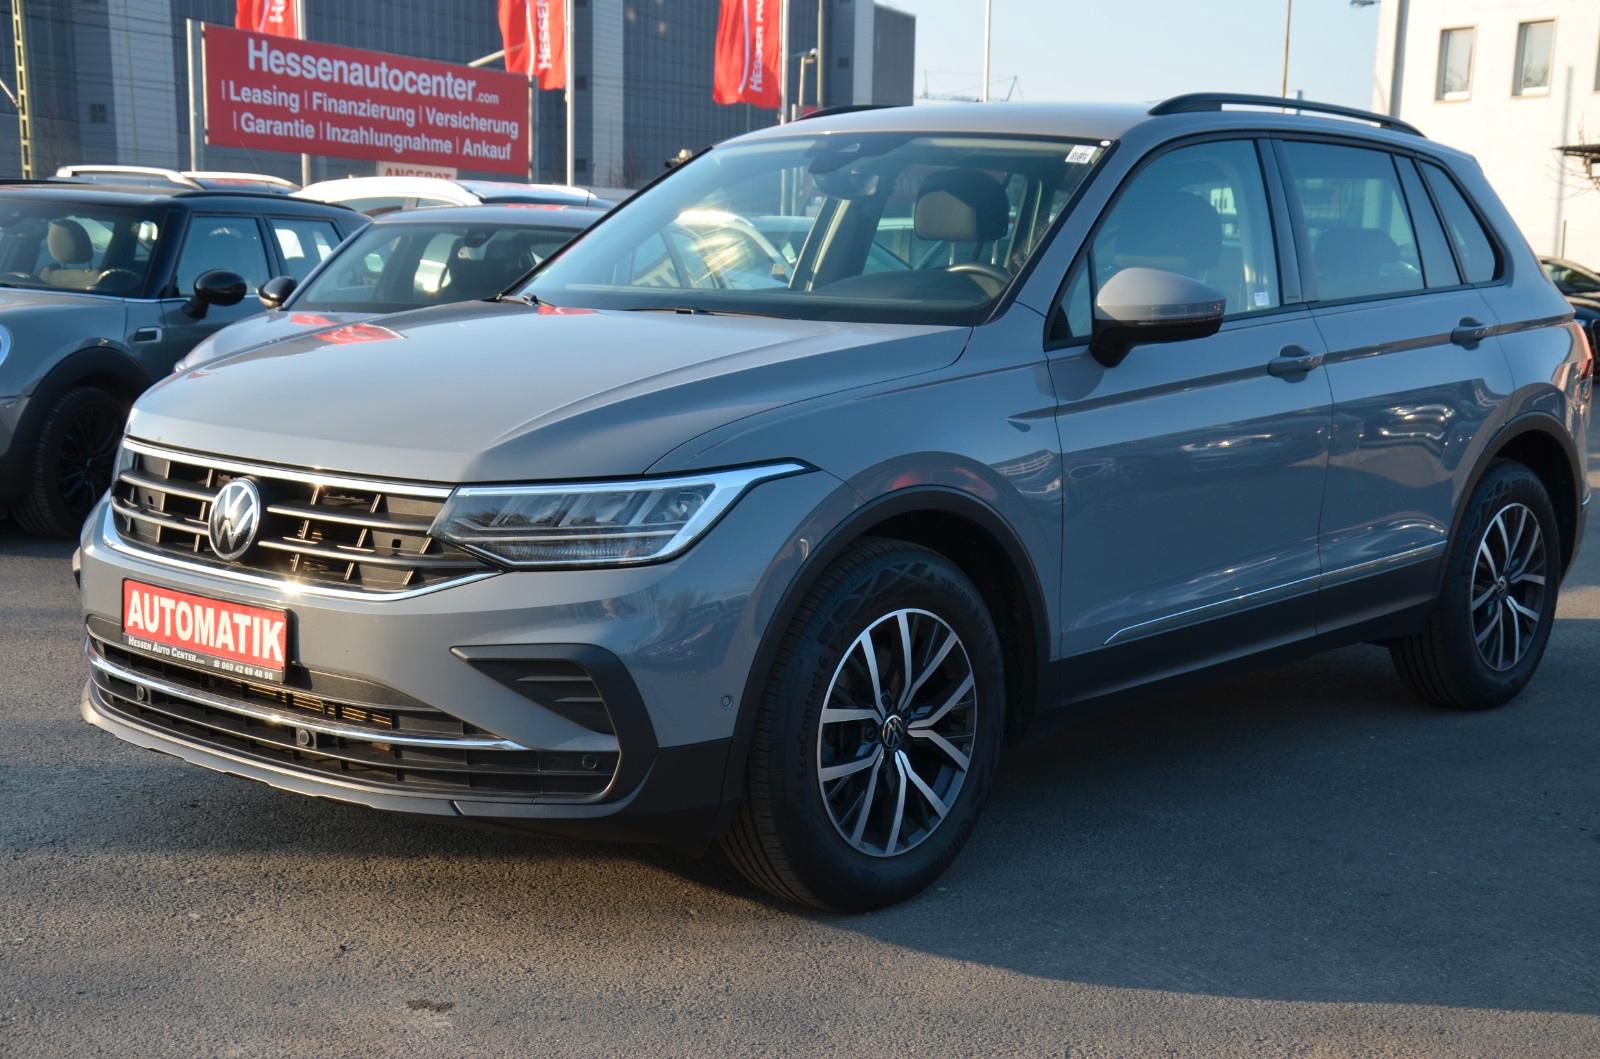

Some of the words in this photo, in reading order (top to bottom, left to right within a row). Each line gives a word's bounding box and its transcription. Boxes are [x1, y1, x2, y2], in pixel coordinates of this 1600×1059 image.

[229, 81, 300, 113] Leasing
[312, 91, 415, 128] Finanzierung
[426, 107, 519, 139] Versicherung
[240, 112, 315, 139] Garantie
[326, 122, 452, 154] Inzahlungnahme
[463, 139, 512, 161] Ankauf
[127, 589, 284, 663] AUTOMATIK
[235, 664, 244, 673] 42
[817, 655, 829, 670] 6
